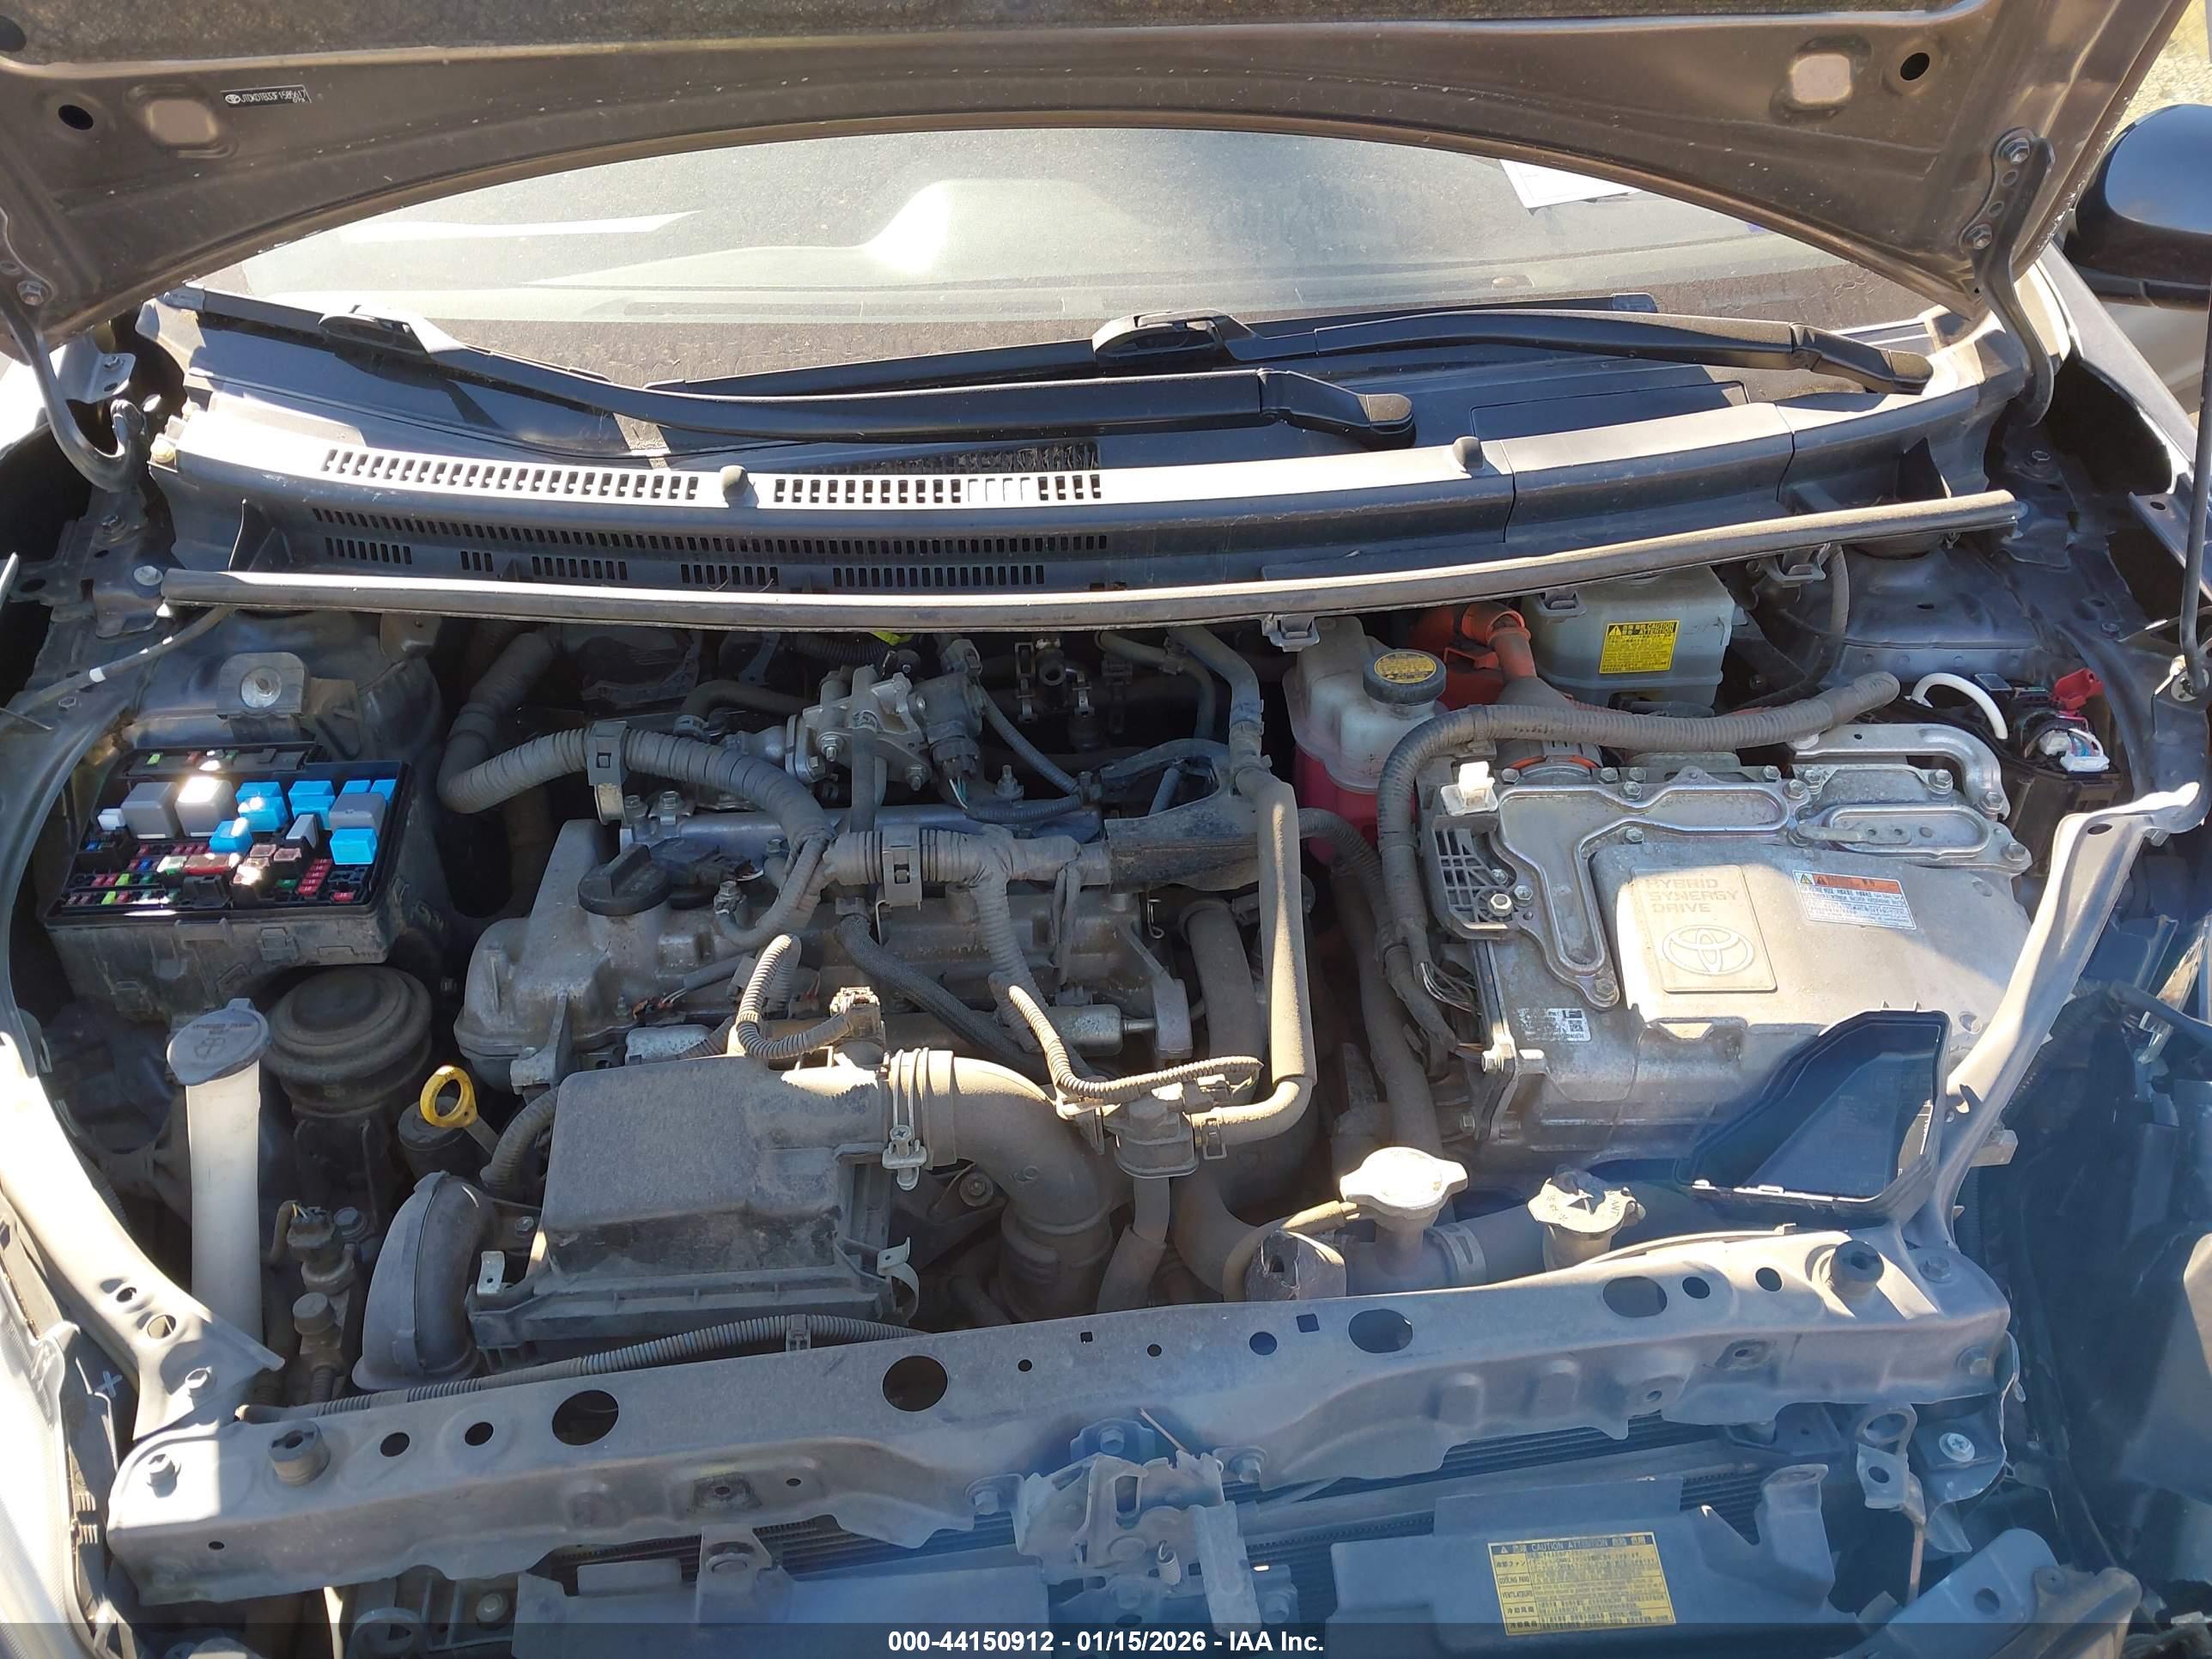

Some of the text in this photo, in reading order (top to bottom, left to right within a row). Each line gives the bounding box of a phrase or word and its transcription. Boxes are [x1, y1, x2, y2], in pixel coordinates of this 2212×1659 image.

[1646, 878, 1718, 889] HYBRID
[1650, 890, 1739, 901] SYNERGY
[1653, 902, 1711, 913] DRIVE
[1532, 1541, 1564, 1552] CAUTION
